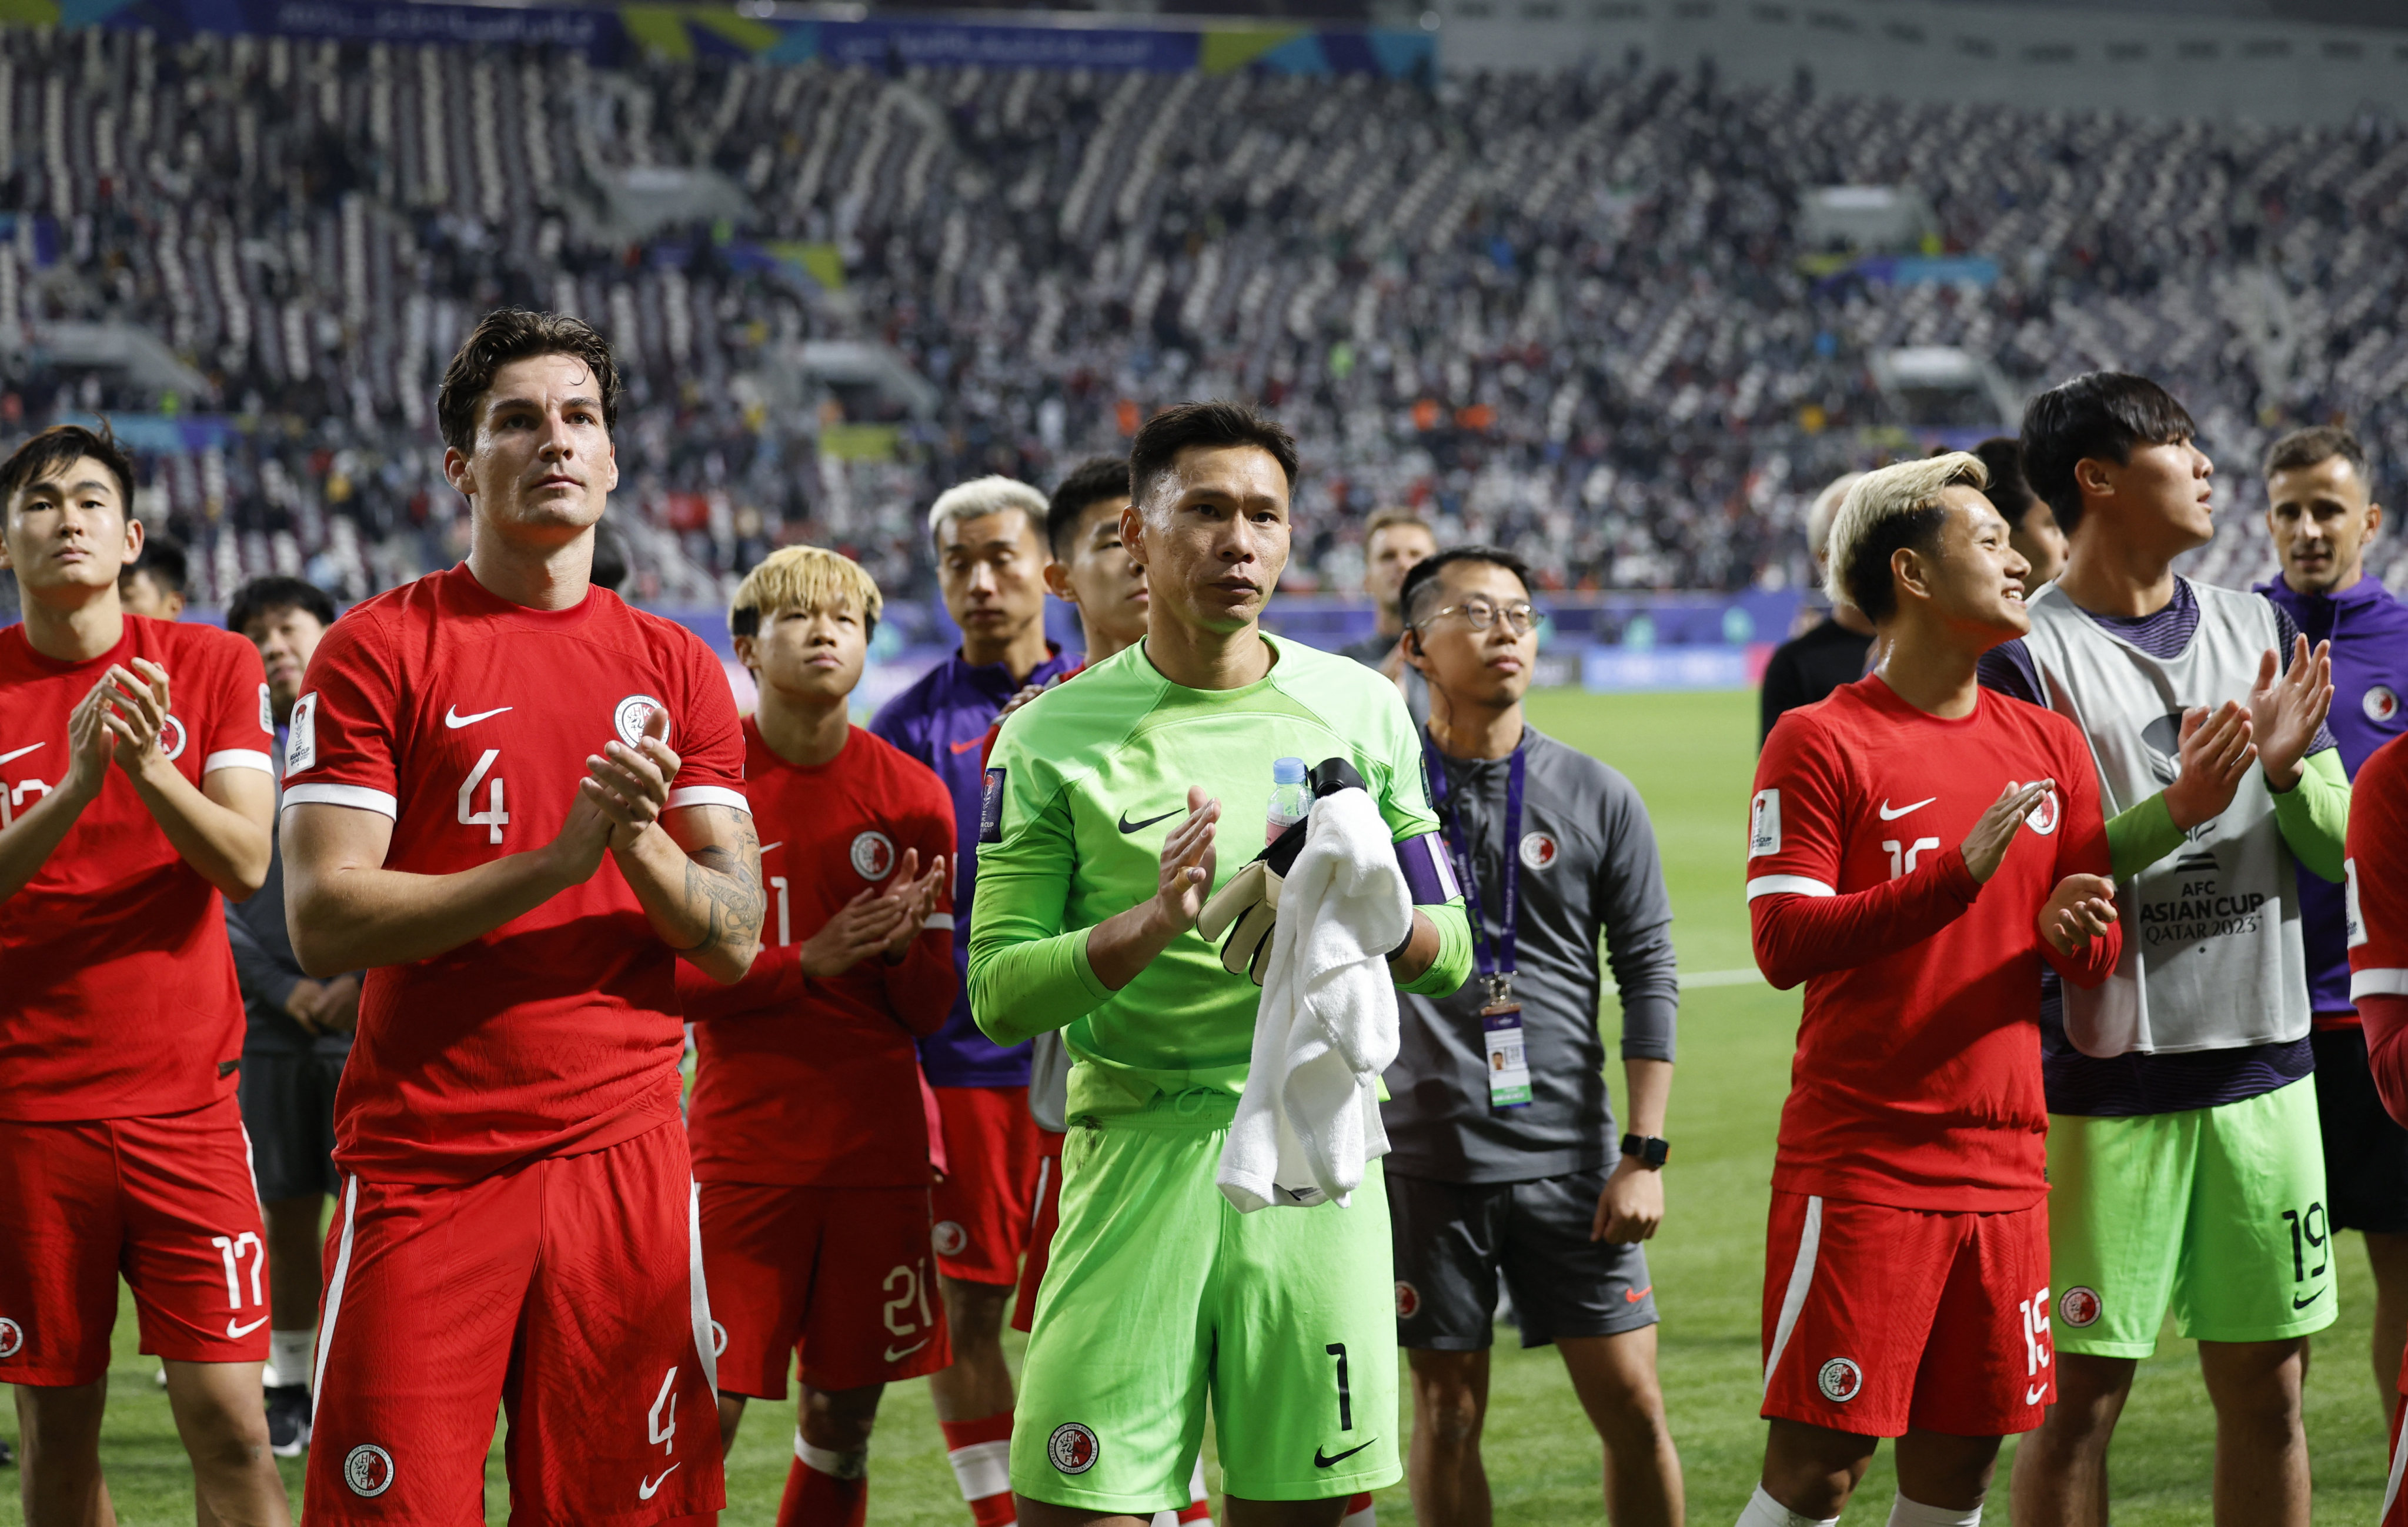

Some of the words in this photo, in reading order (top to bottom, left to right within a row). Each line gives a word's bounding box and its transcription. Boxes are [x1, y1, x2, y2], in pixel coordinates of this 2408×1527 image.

[633, 706, 650, 716] HK
[457, 749, 509, 844] 4
[2181, 880, 2216, 897] AFC
[2140, 899, 2212, 924] ASIAN
[2215, 893, 2264, 917] CUP
[2146, 923, 2207, 946] QATAR
[2282, 1202, 2327, 1282] 19
[211, 1231, 264, 1309] 17
[883, 1256, 934, 1336] 21
[2019, 1286, 2050, 1376] 15
[1325, 1343, 1352, 1431] 1
[648, 1366, 678, 1456] 4
[1066, 1433, 1082, 1443] HK
[1080, 1427, 1092, 1437] KONG
[361, 1454, 376, 1464] HK
[375, 1447, 387, 1458] KONG
[1050, 1442, 1061, 1468] FOOTBALL
[1062, 1458, 1094, 1472] ASSOCIATION
[1065, 1455, 1080, 1465] FA
[345, 1465, 357, 1491] FOOTBALL
[360, 1477, 375, 1488] FA
